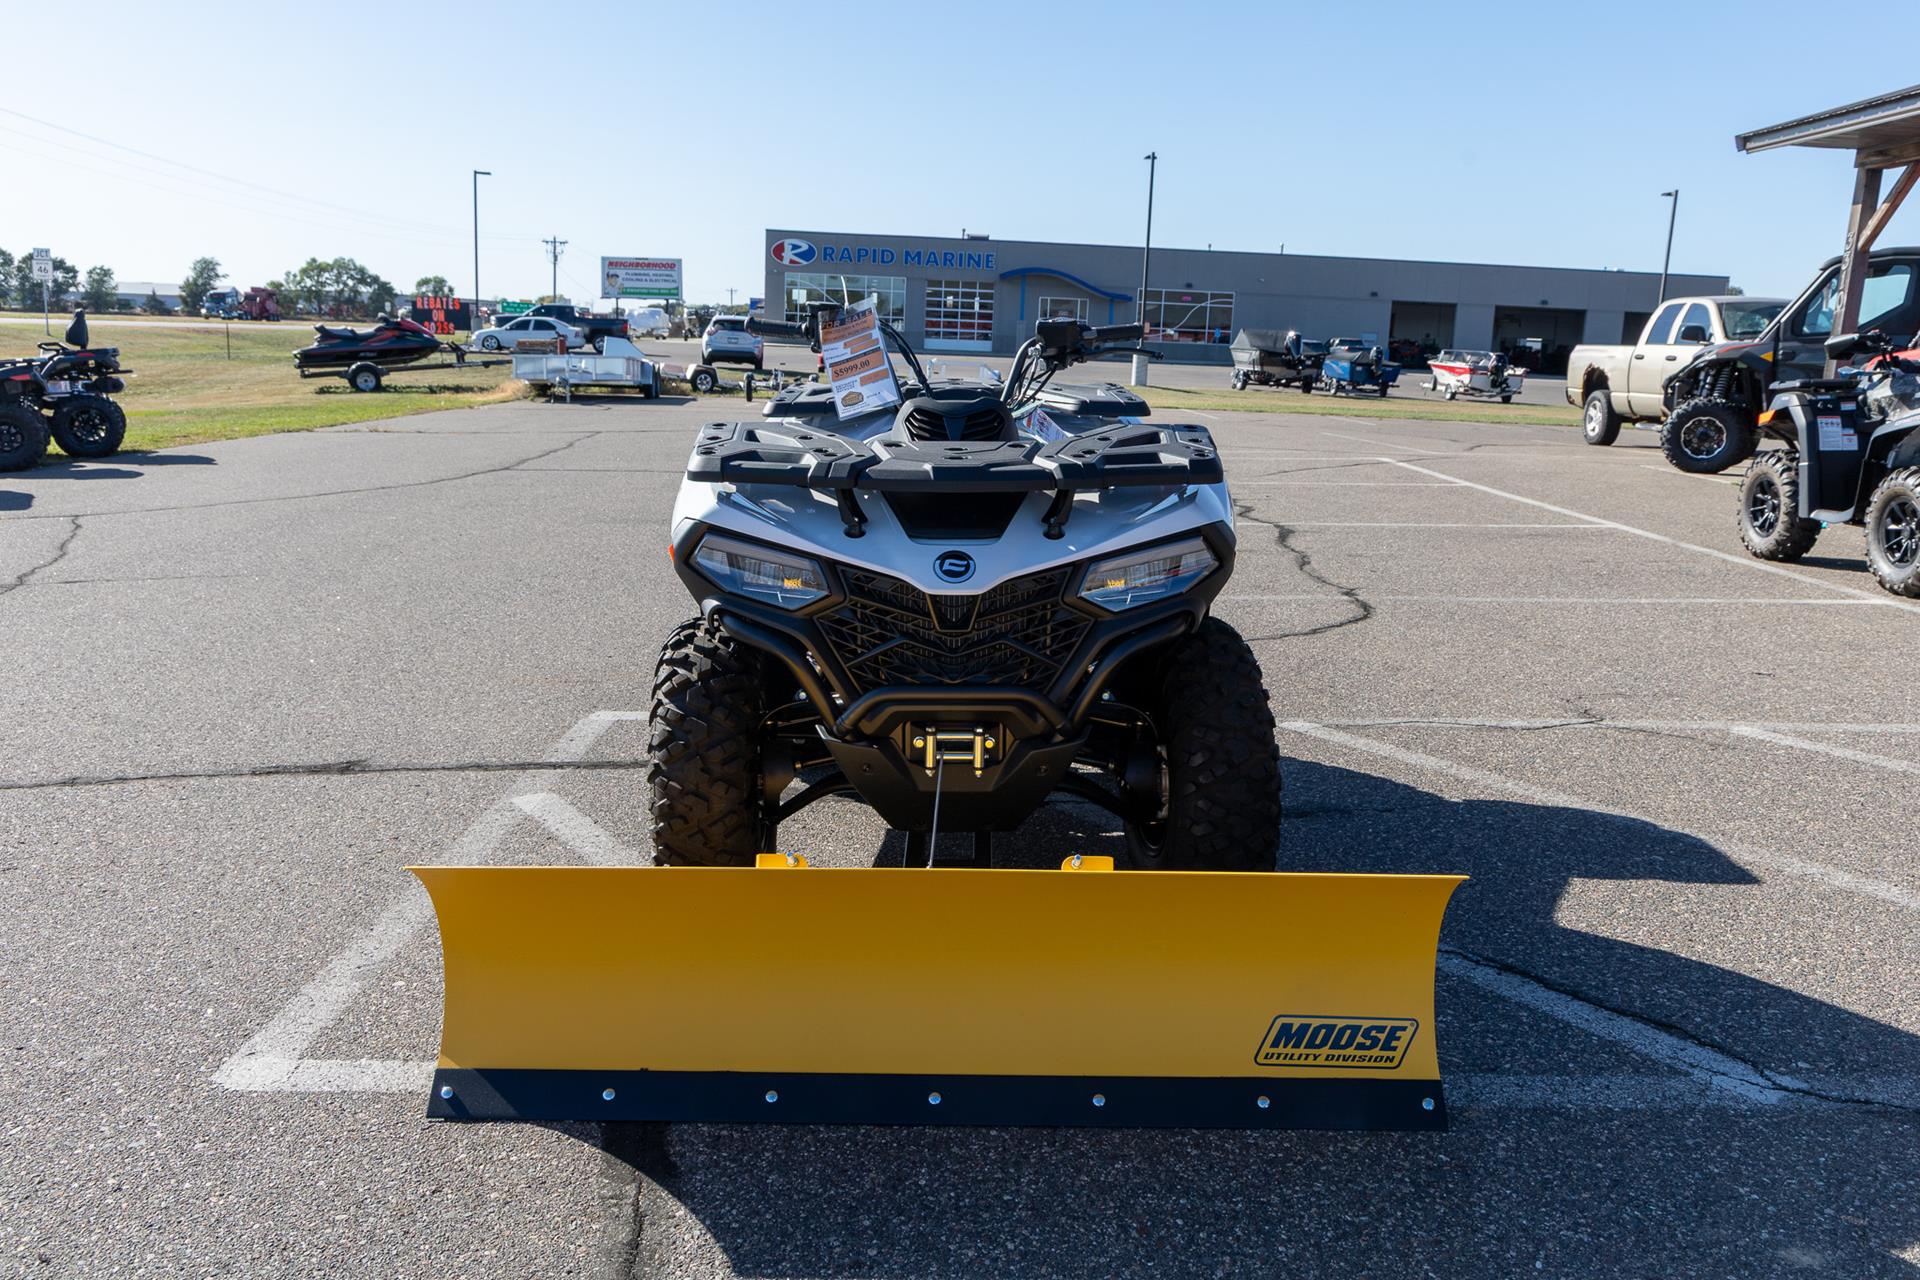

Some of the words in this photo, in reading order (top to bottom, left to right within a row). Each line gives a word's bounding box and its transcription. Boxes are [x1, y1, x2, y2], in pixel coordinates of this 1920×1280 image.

[821, 246, 896, 265] RAPID
[903, 250, 996, 270] MARINE
[37, 265, 48, 273] 46
[607, 261, 677, 269] NEIGHBORHOOD
[416, 296, 461, 310] REBATES
[432, 309, 445, 322] ON
[833, 359, 870, 377] $5999.00
[1270, 1022, 1408, 1051] MOOSE
[1263, 1052, 1322, 1062] UTILITY
[1324, 1053, 1396, 1064] DIVISION
